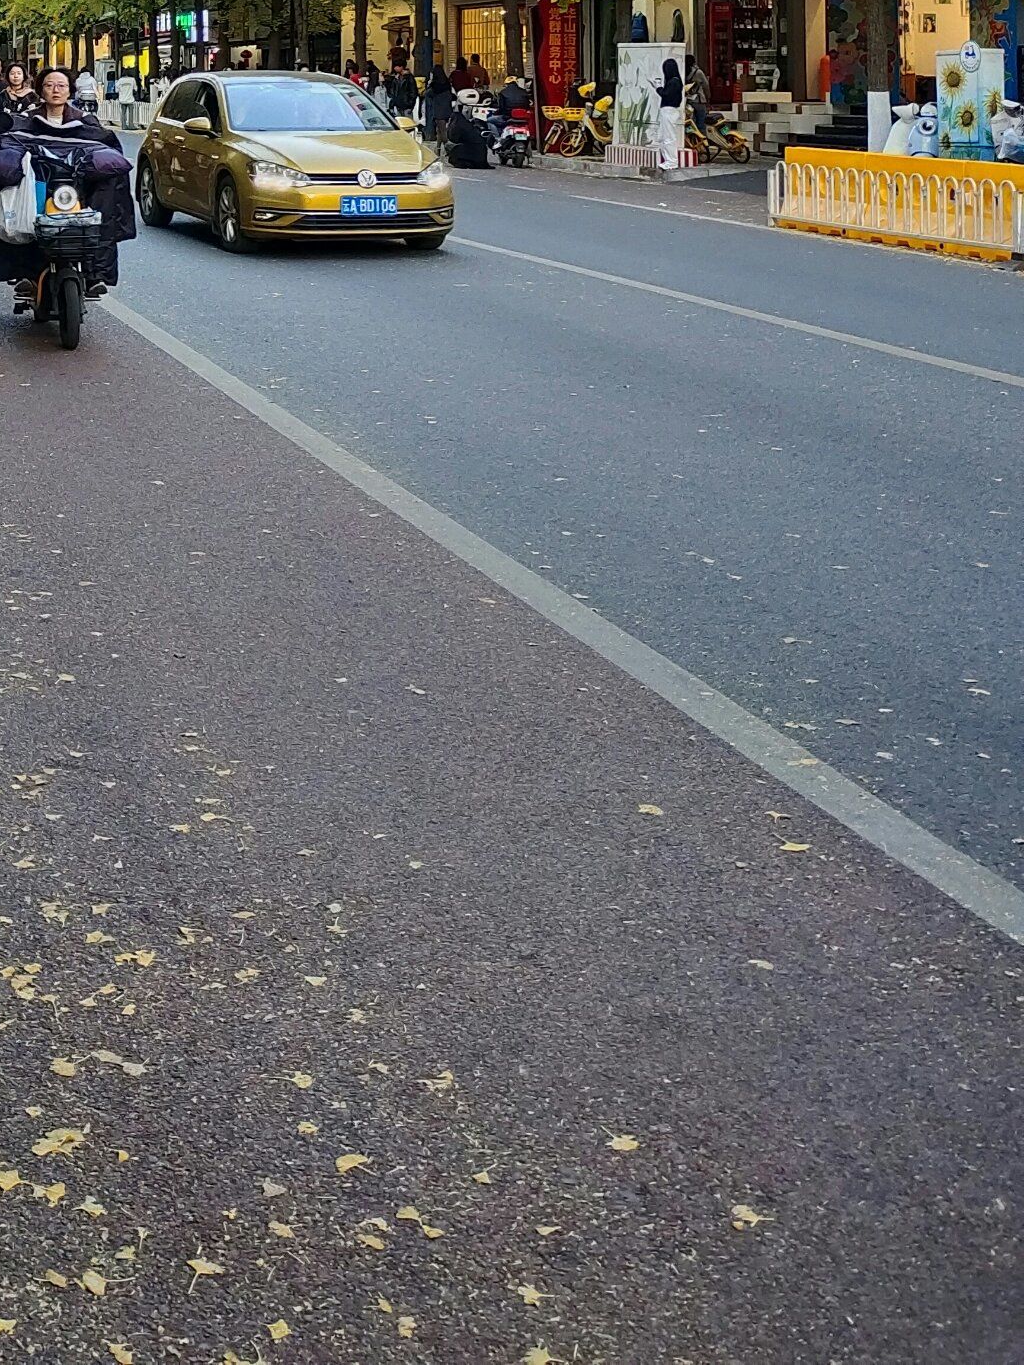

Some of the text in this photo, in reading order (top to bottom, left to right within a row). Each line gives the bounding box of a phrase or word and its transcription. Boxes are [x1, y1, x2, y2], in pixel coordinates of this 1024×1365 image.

[549, 7, 562, 85] 党群服务中心
